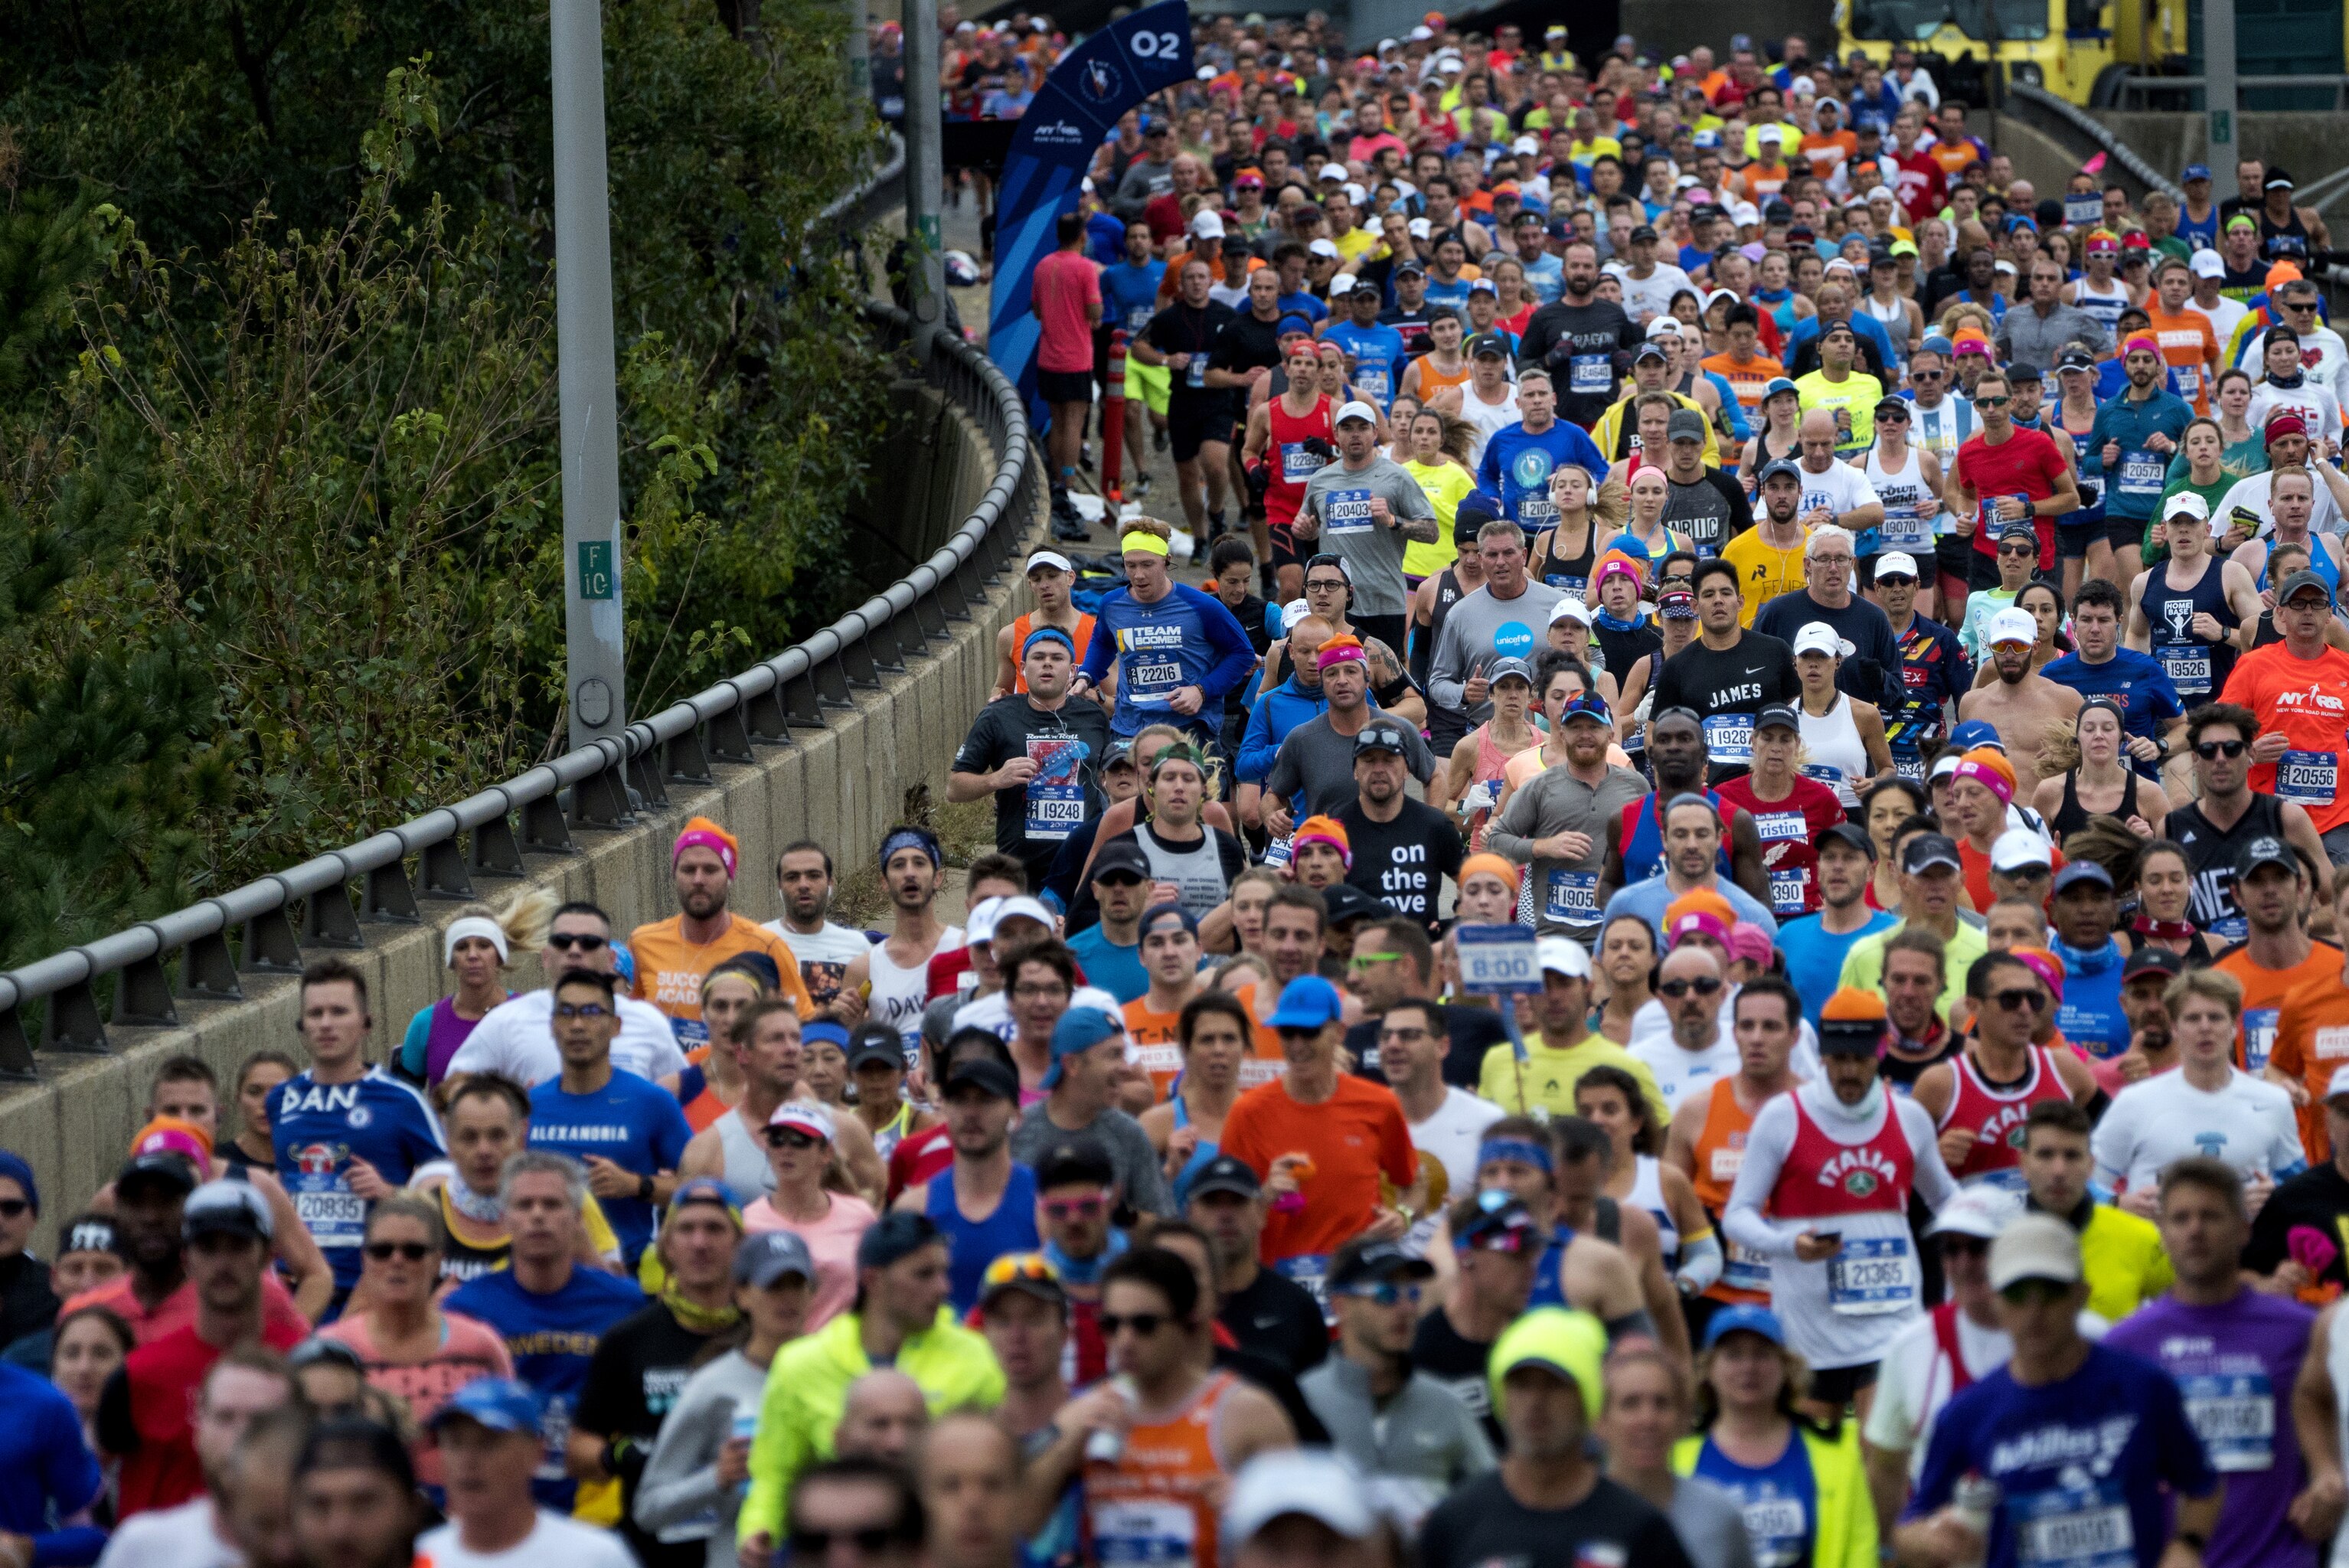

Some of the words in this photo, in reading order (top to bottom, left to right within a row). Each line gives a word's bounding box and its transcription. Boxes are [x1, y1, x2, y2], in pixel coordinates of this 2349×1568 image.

[2129, 466, 2161, 478] 20573
[1336, 504, 1368, 518] 20403
[1886, 521, 1916, 534] 19070
[590, 546, 600, 568] F
[1134, 626, 1181, 636] TEAM
[1135, 635, 1182, 645] BOOMER
[1496, 634, 1521, 645] unicef
[1131, 668, 1136, 676] 2
[1142, 666, 1176, 683] 22216
[1903, 671, 1921, 682] EX
[2171, 662, 2205, 677] 19526
[1709, 683, 1761, 708] JAMES
[1706, 729, 1712, 737] 2
[1718, 730, 1753, 745] 19287
[1707, 737, 1713, 746] A
[1895, 763, 1923, 776] 534
[2283, 766, 2289, 774] 2
[2292, 768, 2334, 786] 20556
[2282, 774, 2288, 784] B
[1031, 801, 1037, 810] 2
[1044, 802, 1080, 819] 19248
[1031, 811, 1037, 819] A
[1779, 812, 1789, 820] girl.
[1759, 822, 1799, 837] ristin
[1272, 848, 1287, 857] 2017
[1391, 844, 1426, 863] on
[1380, 867, 1427, 890] the
[1552, 885, 1557, 894] 2
[1772, 884, 1800, 900] 390
[2192, 867, 2236, 922] NE
[1553, 896, 1558, 905] A
[1563, 889, 1595, 907] 1905
[1472, 957, 1529, 978] 8:00
[656, 971, 700, 988] SUCC
[656, 990, 698, 1005] ACAD
[887, 995, 927, 1019] DAV
[280, 1085, 358, 1115] DAN
[1978, 1101, 2032, 1145] ITAL
[529, 1125, 629, 1142] ALEXANDRIA
[1817, 1147, 1897, 1187] ITALIA
[302, 1196, 359, 1219] 20835
[1851, 1264, 1903, 1285] 21365
